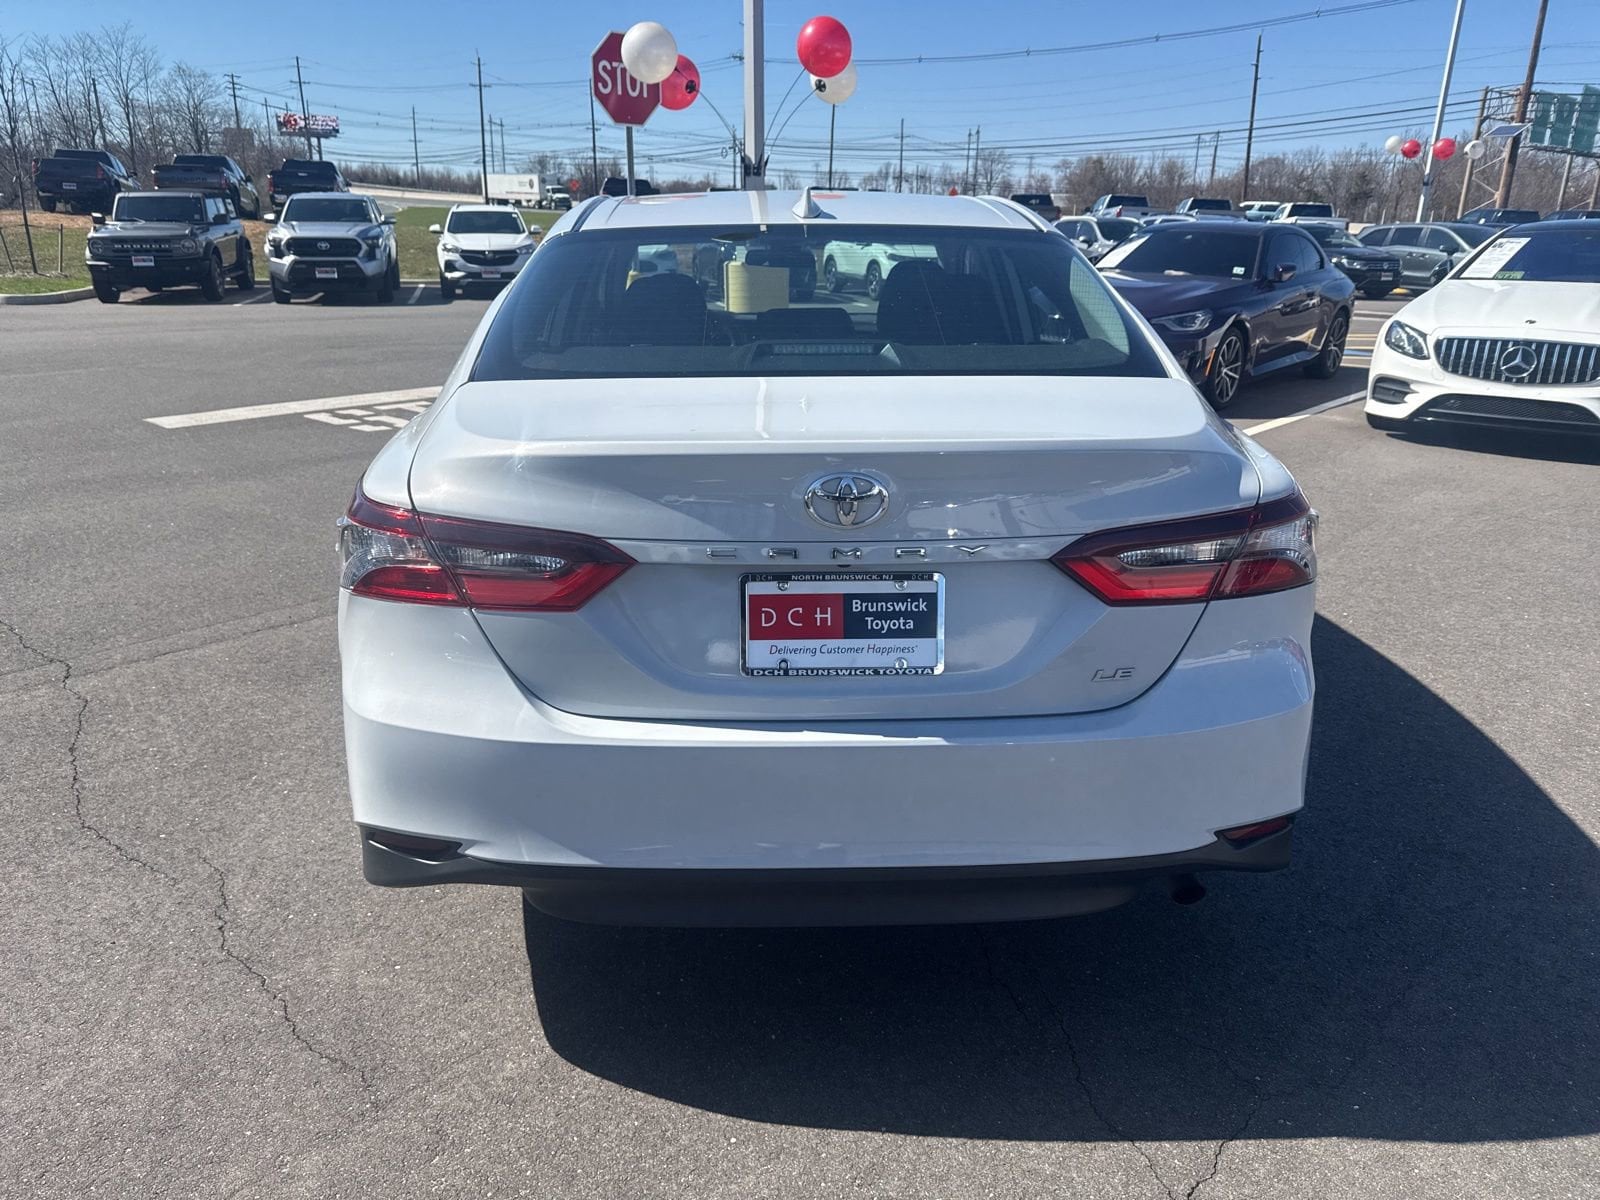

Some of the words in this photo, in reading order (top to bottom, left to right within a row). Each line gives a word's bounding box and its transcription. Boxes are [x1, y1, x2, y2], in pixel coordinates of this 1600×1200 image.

[706, 544, 989, 559] CAMRY
[852, 598, 928, 612] Brunswick
[865, 617, 914, 633] Toyota
[769, 644, 817, 657] Delivering
[819, 643, 865, 655] Customer
[788, 668, 874, 676] BRUNSWICK
